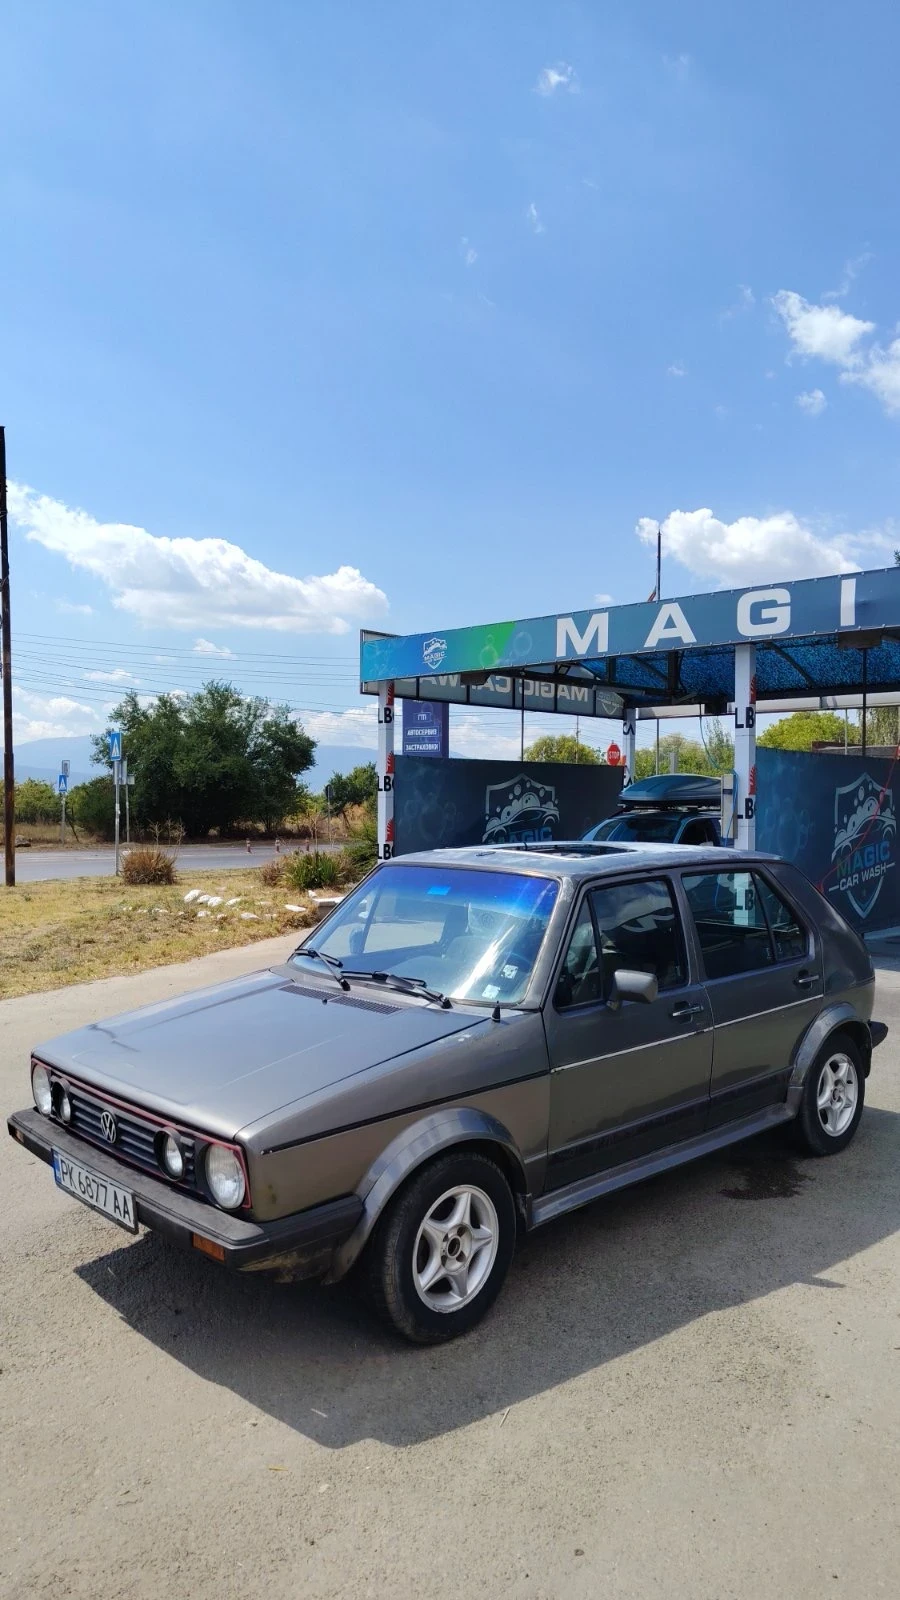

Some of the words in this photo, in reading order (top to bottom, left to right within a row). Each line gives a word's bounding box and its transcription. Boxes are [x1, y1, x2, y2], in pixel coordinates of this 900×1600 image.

[378, 707, 394, 723] LB
[608, 751, 620, 760] STOP
[377, 776, 394, 792] LB
[836, 841, 890, 878] MAGIC
[840, 874, 858, 890] CAR
[862, 862, 886, 882] WASH
[60, 1159, 76, 1188] PK
[78, 1171, 108, 1208] 6877
[114, 1190, 132, 1223] AA
